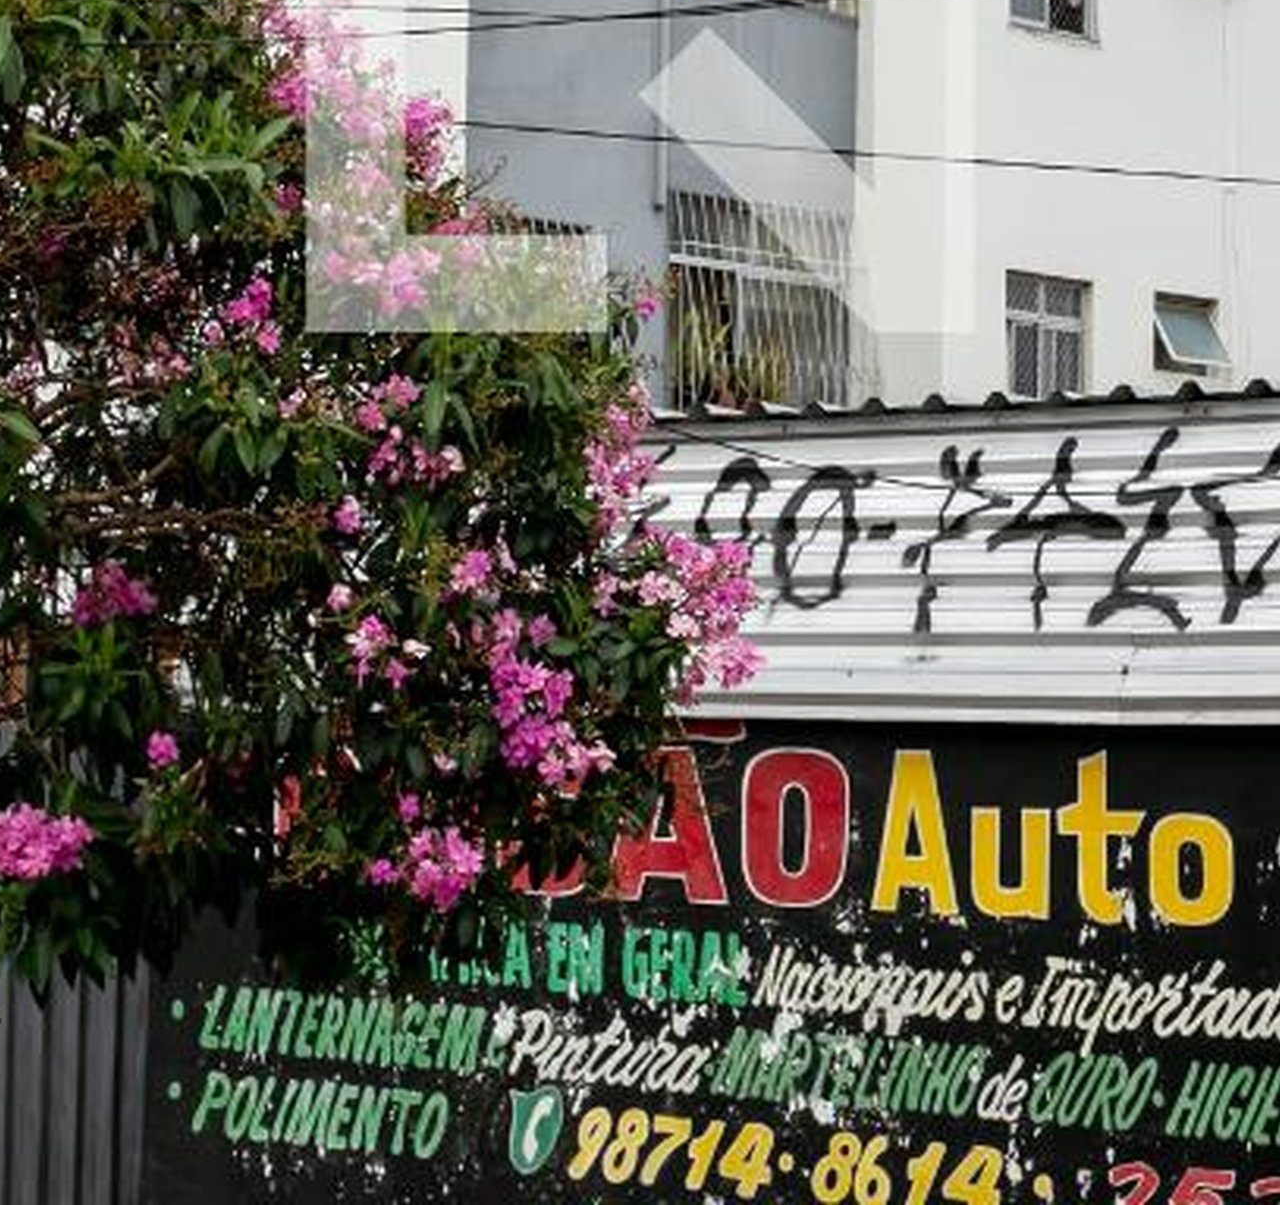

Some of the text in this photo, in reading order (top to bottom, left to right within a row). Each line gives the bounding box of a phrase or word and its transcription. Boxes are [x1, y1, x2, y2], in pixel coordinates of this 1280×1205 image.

[870, 749, 1234, 927] Auto
[546, 920, 606, 995] EM
[621, 927, 749, 1007] GERAL
[995, 973, 1024, 1024] e
[191, 1070, 449, 1160] POLIMENTO
[198, 984, 488, 1077] LANTERNAGEM
[976, 1054, 1029, 1122] de
[1028, 1051, 1158, 1131] OURO
